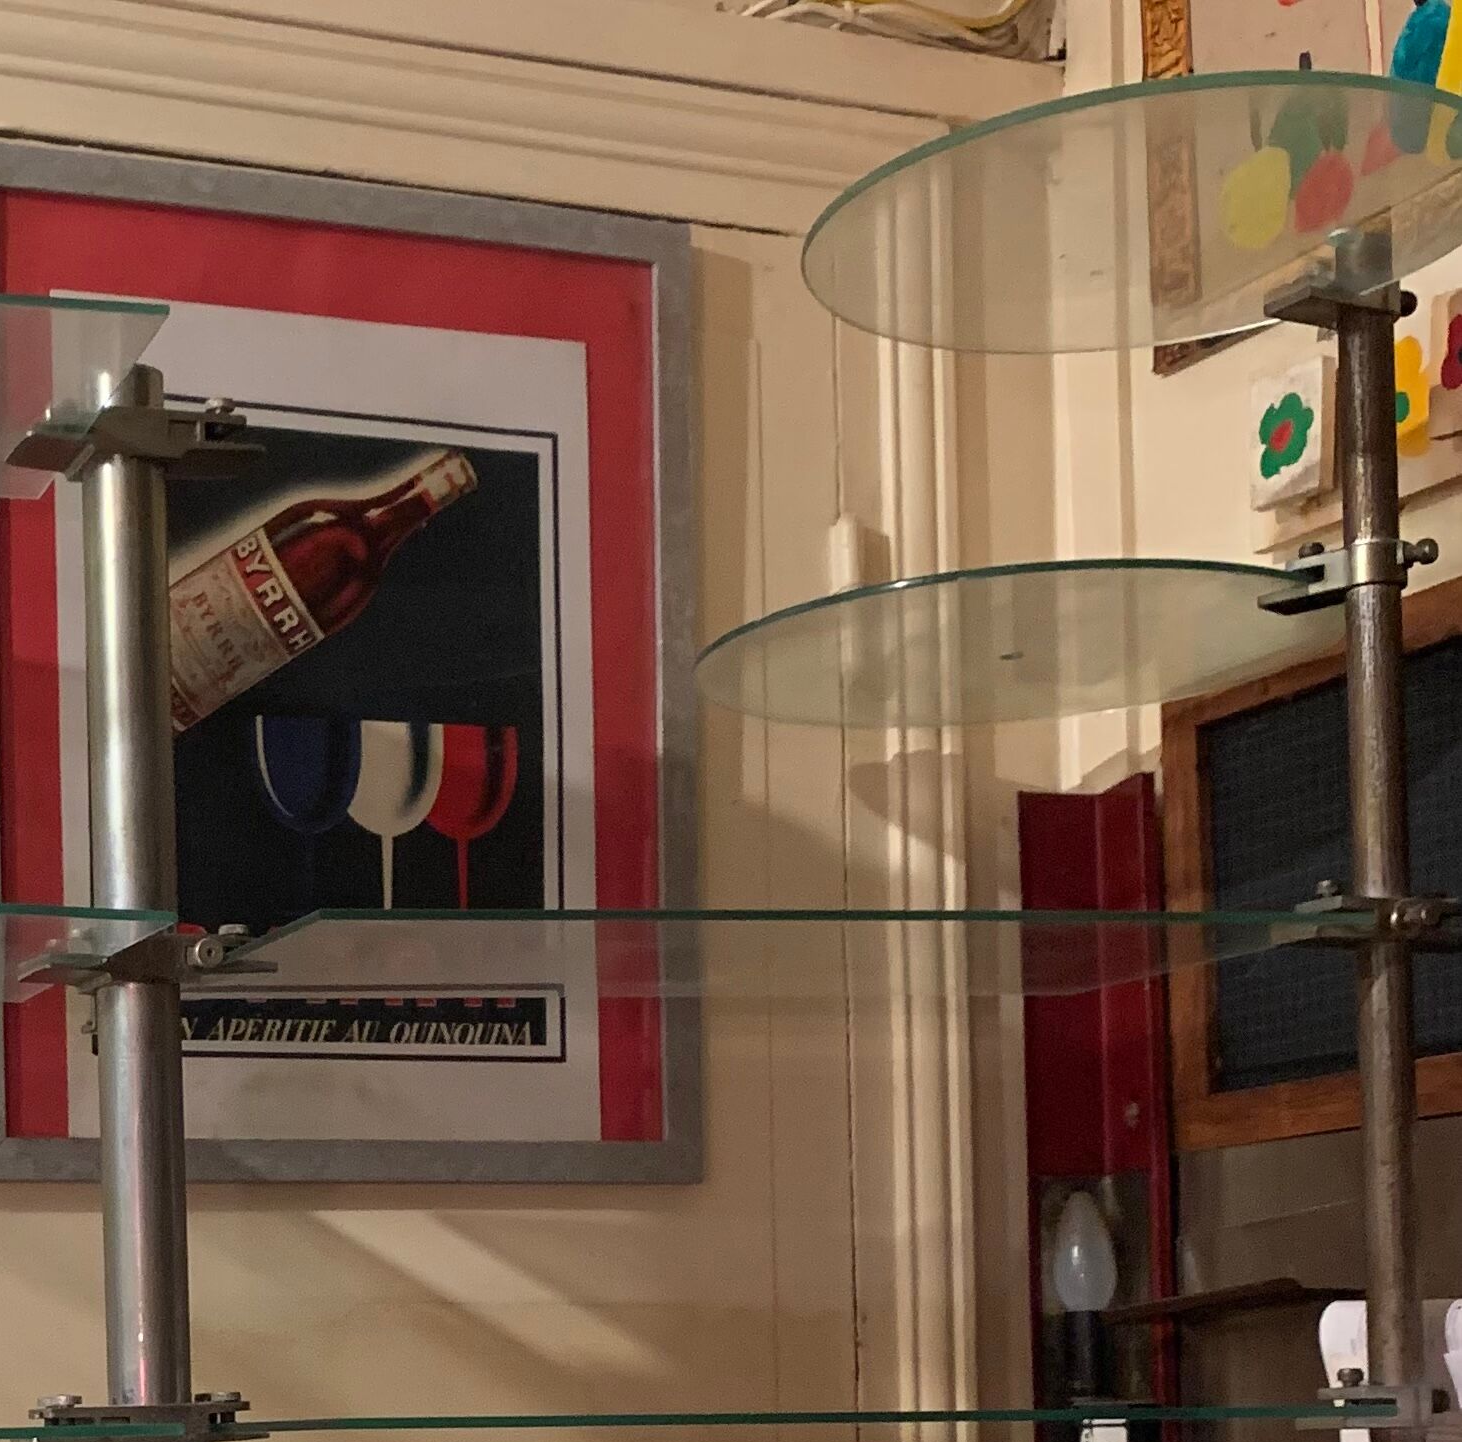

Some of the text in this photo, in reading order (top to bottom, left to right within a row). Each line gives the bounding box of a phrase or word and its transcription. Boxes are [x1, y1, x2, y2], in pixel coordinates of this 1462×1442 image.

[236, 535, 315, 651] BYRRH
[341, 1018, 381, 1043] AU
[387, 1020, 533, 1046] QUINQUINA
